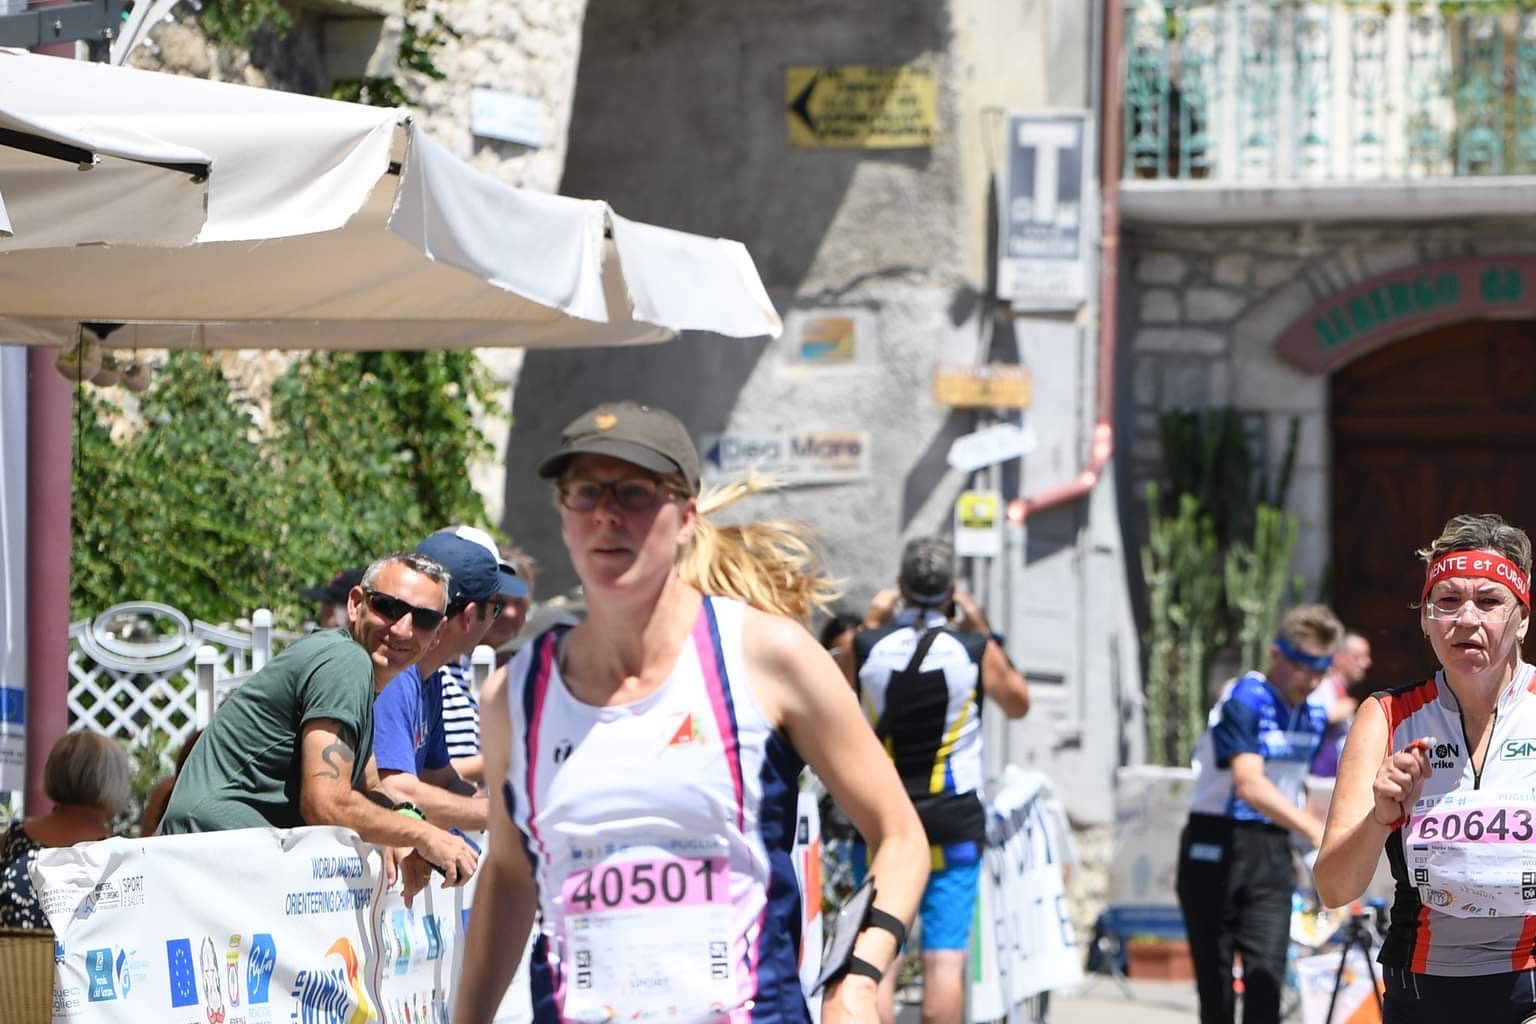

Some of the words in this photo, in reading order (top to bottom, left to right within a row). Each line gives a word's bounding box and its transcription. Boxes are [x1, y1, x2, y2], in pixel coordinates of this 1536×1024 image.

[789, 434, 863, 458] Mare
[1473, 559, 1492, 571] et
[1419, 808, 1533, 841] 60643
[311, 857, 336, 880] WORLD
[122, 875, 144, 893] SPORT
[571, 860, 713, 910] 40501
[286, 891, 334, 915] ORIENTEERING
